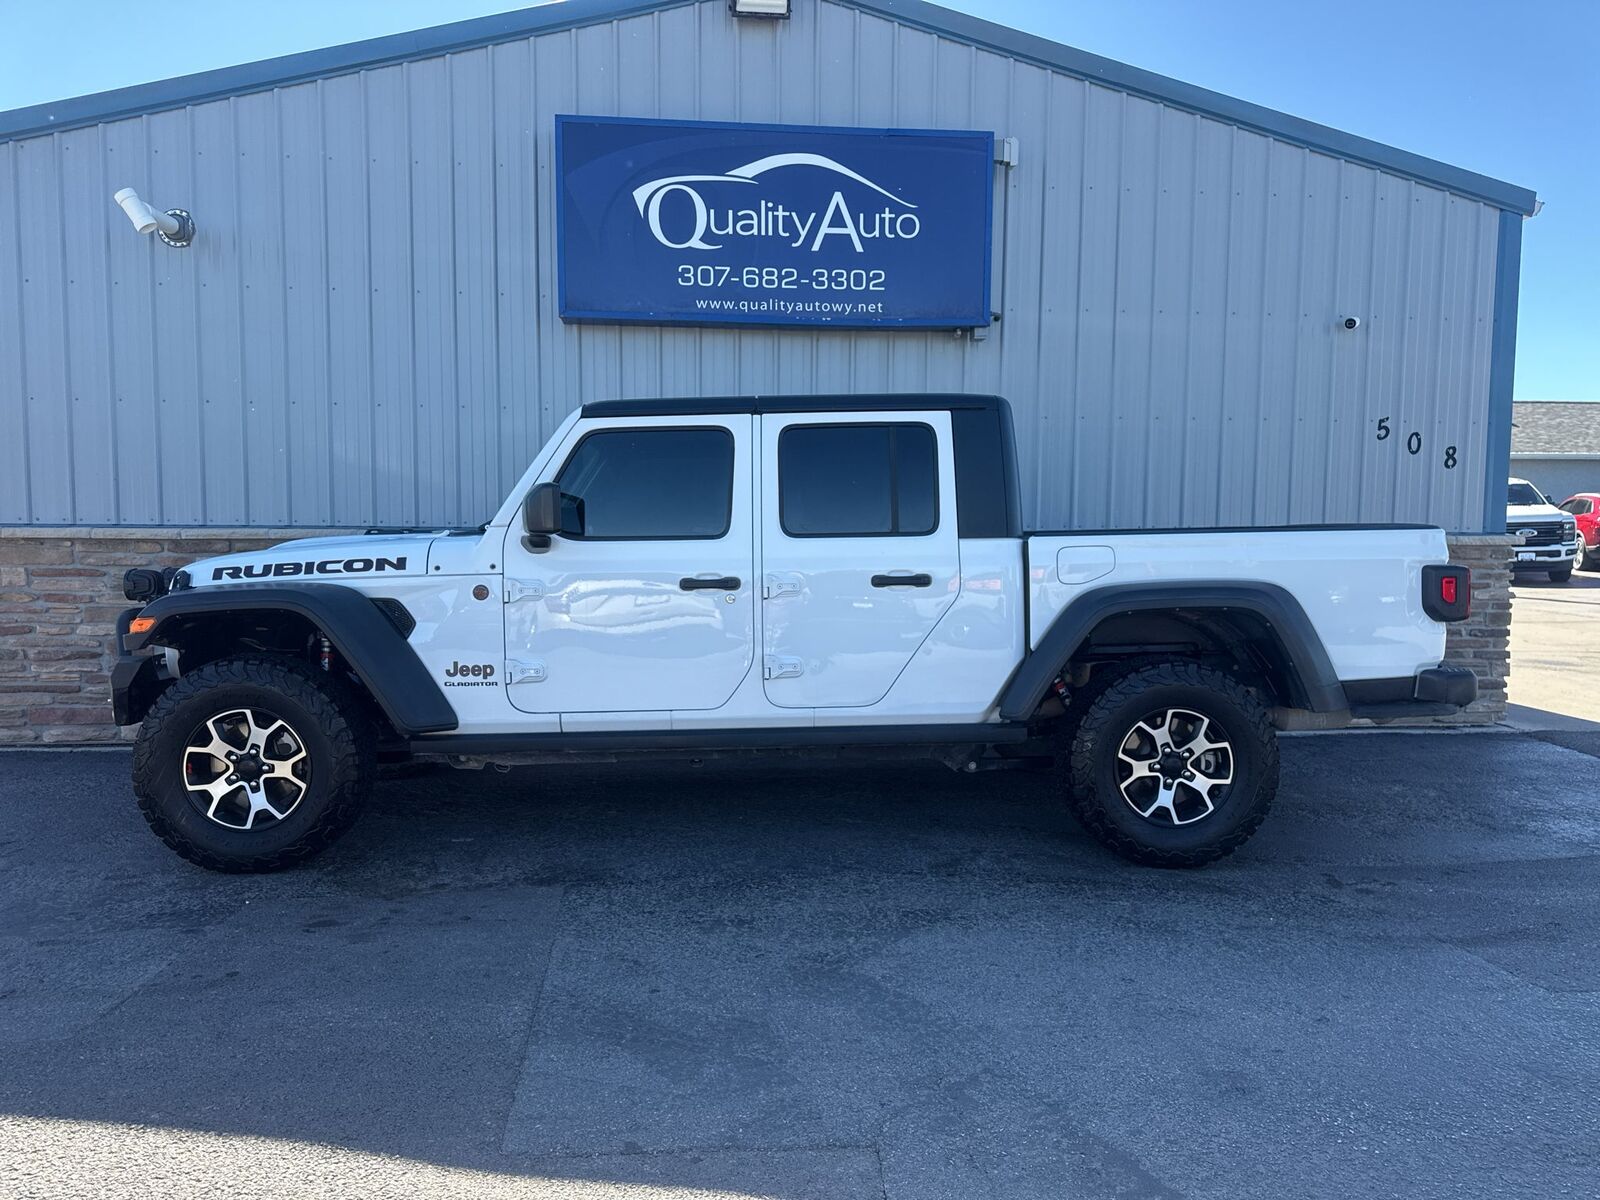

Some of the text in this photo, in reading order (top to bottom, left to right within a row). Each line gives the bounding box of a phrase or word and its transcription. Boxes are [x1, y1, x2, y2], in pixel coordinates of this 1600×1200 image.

[677, 264, 886, 291] 307-682-3302
[695, 297, 884, 314] www.qualityautowy.net
[212, 556, 407, 581] RUBICON
[445, 661, 495, 680] Jeep
